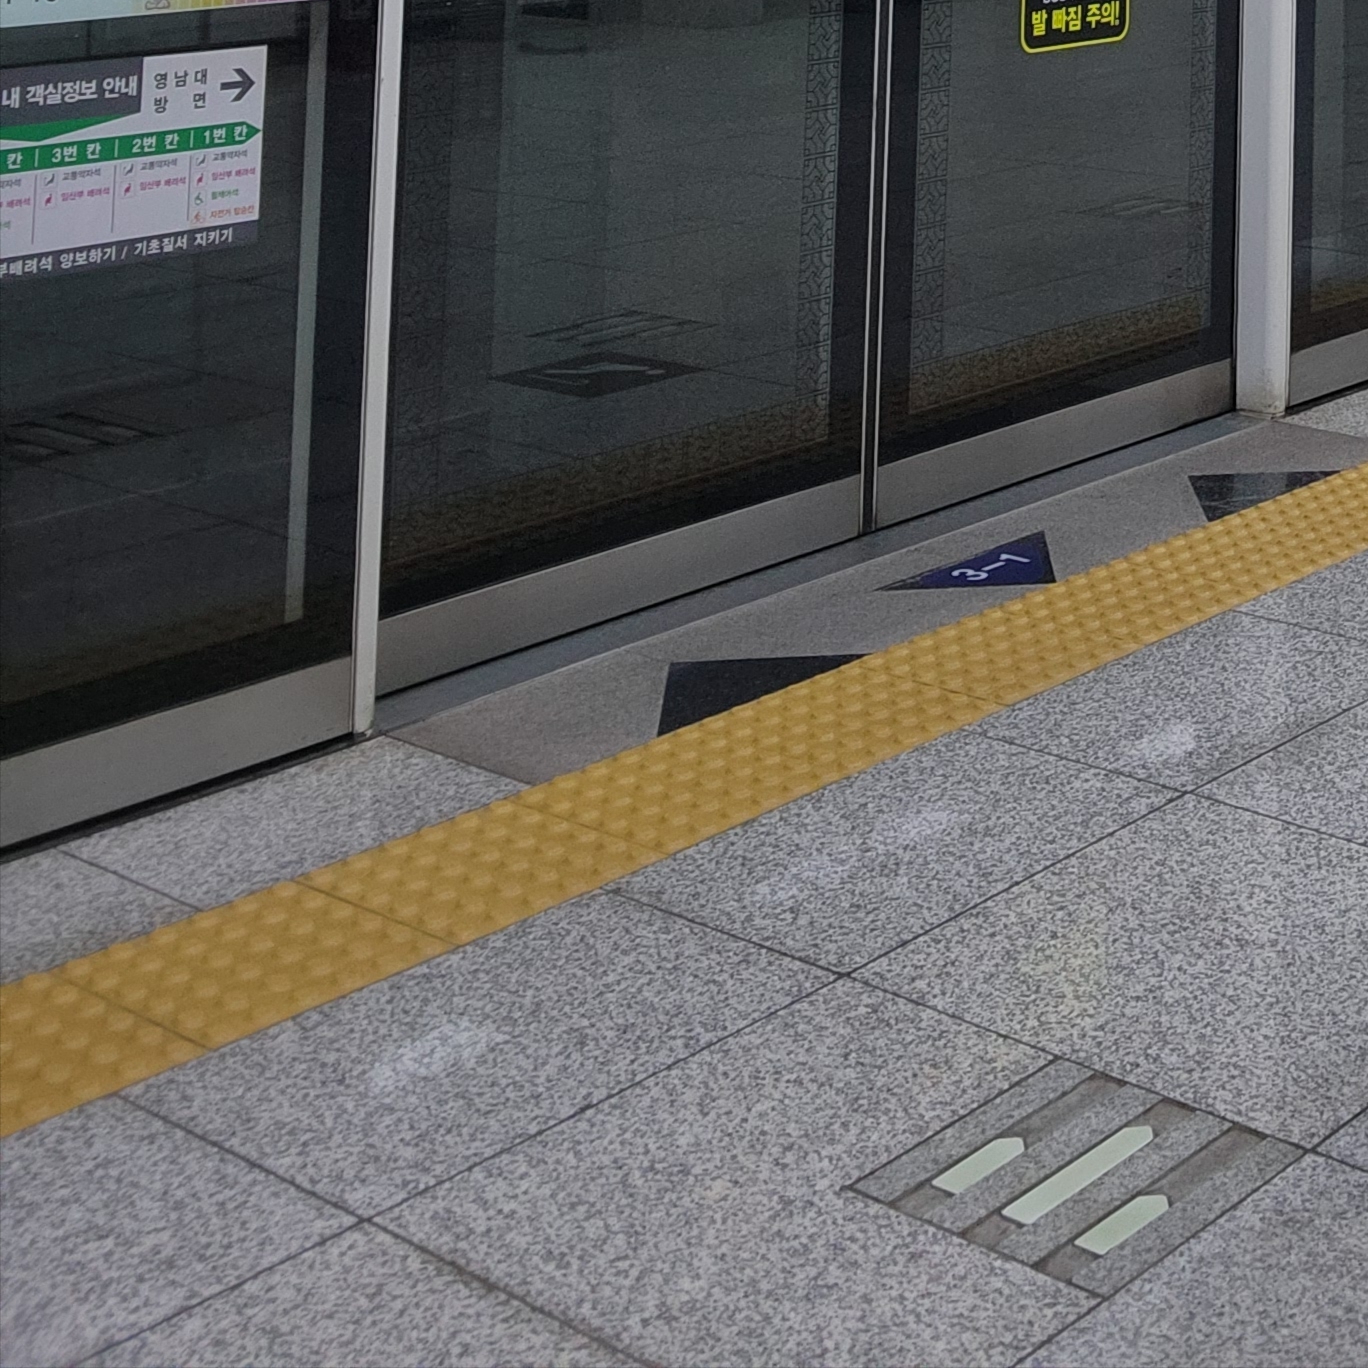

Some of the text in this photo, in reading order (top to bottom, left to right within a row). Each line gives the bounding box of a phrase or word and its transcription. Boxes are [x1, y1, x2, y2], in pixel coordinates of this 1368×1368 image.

[1031, 0, 1120, 37] 발 빠짐 주의!
[1, 73, 140, 111] 내 객실정보 안내
[7, 123, 248, 171] 칸 3번 칸 2번 칸 1번 칸
[59, 244, 117, 271] 양보하기
[134, 234, 190, 257] 기초질서
[194, 226, 234, 247] 지키기
[951, 552, 1031, 582] 3-1
